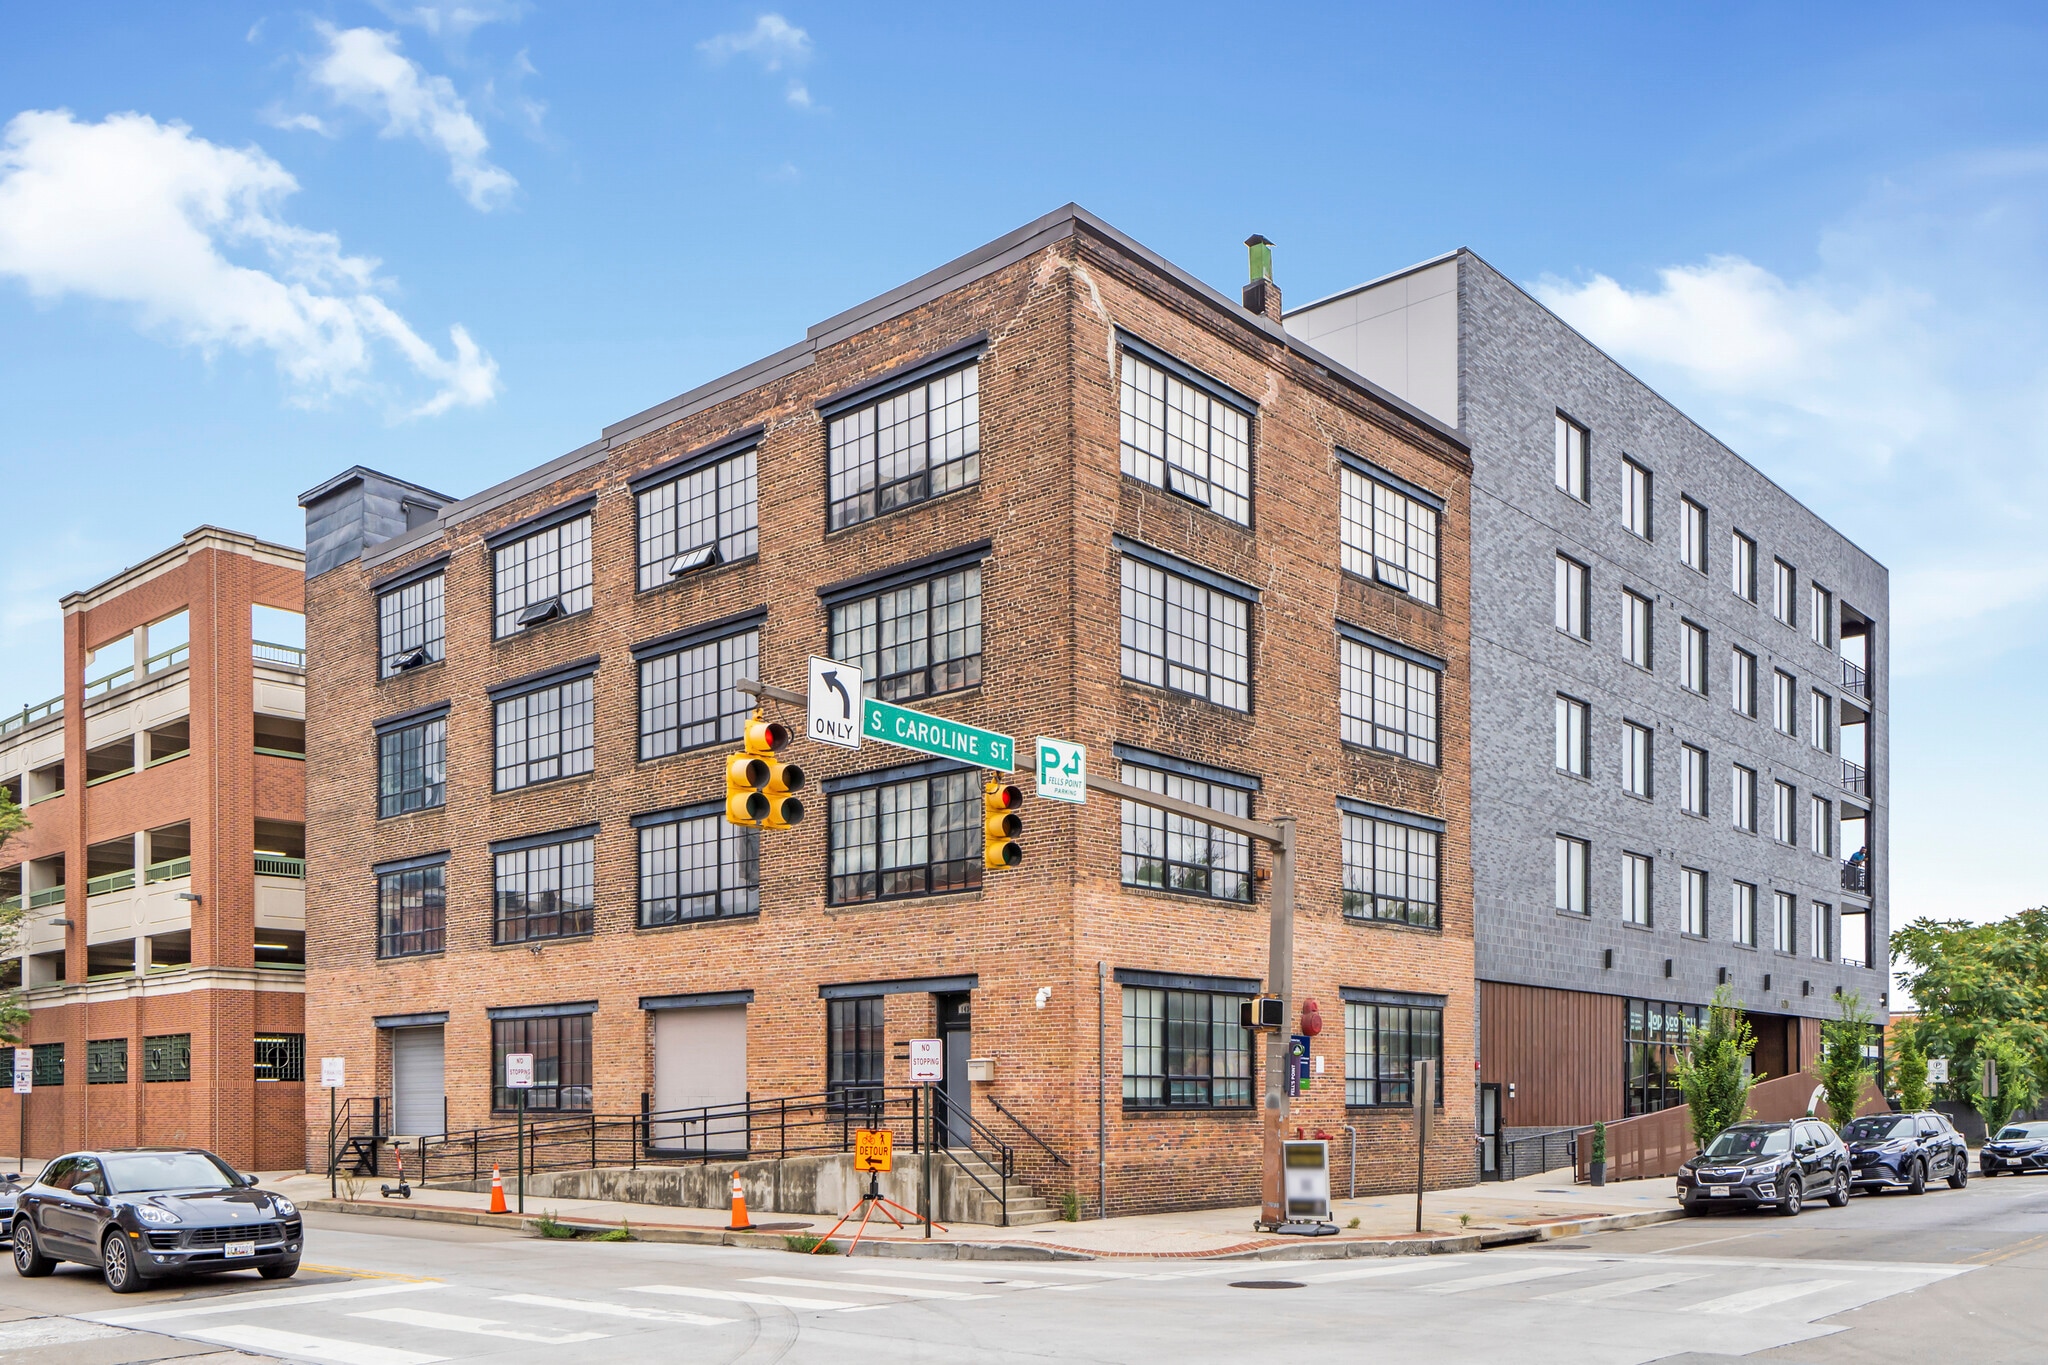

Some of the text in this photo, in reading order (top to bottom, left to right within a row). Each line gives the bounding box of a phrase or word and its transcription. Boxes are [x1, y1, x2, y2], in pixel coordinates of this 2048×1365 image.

[816, 718, 853, 739] ONLY
[871, 710, 1009, 762] S. CAROLINE ST.
[1041, 746, 1060, 785] P
[1049, 776, 1082, 789] FELLS POINT
[1054, 787, 1077, 796] PARKING
[921, 1044, 931, 1052] NO
[860, 1146, 888, 1156] DETOUR
